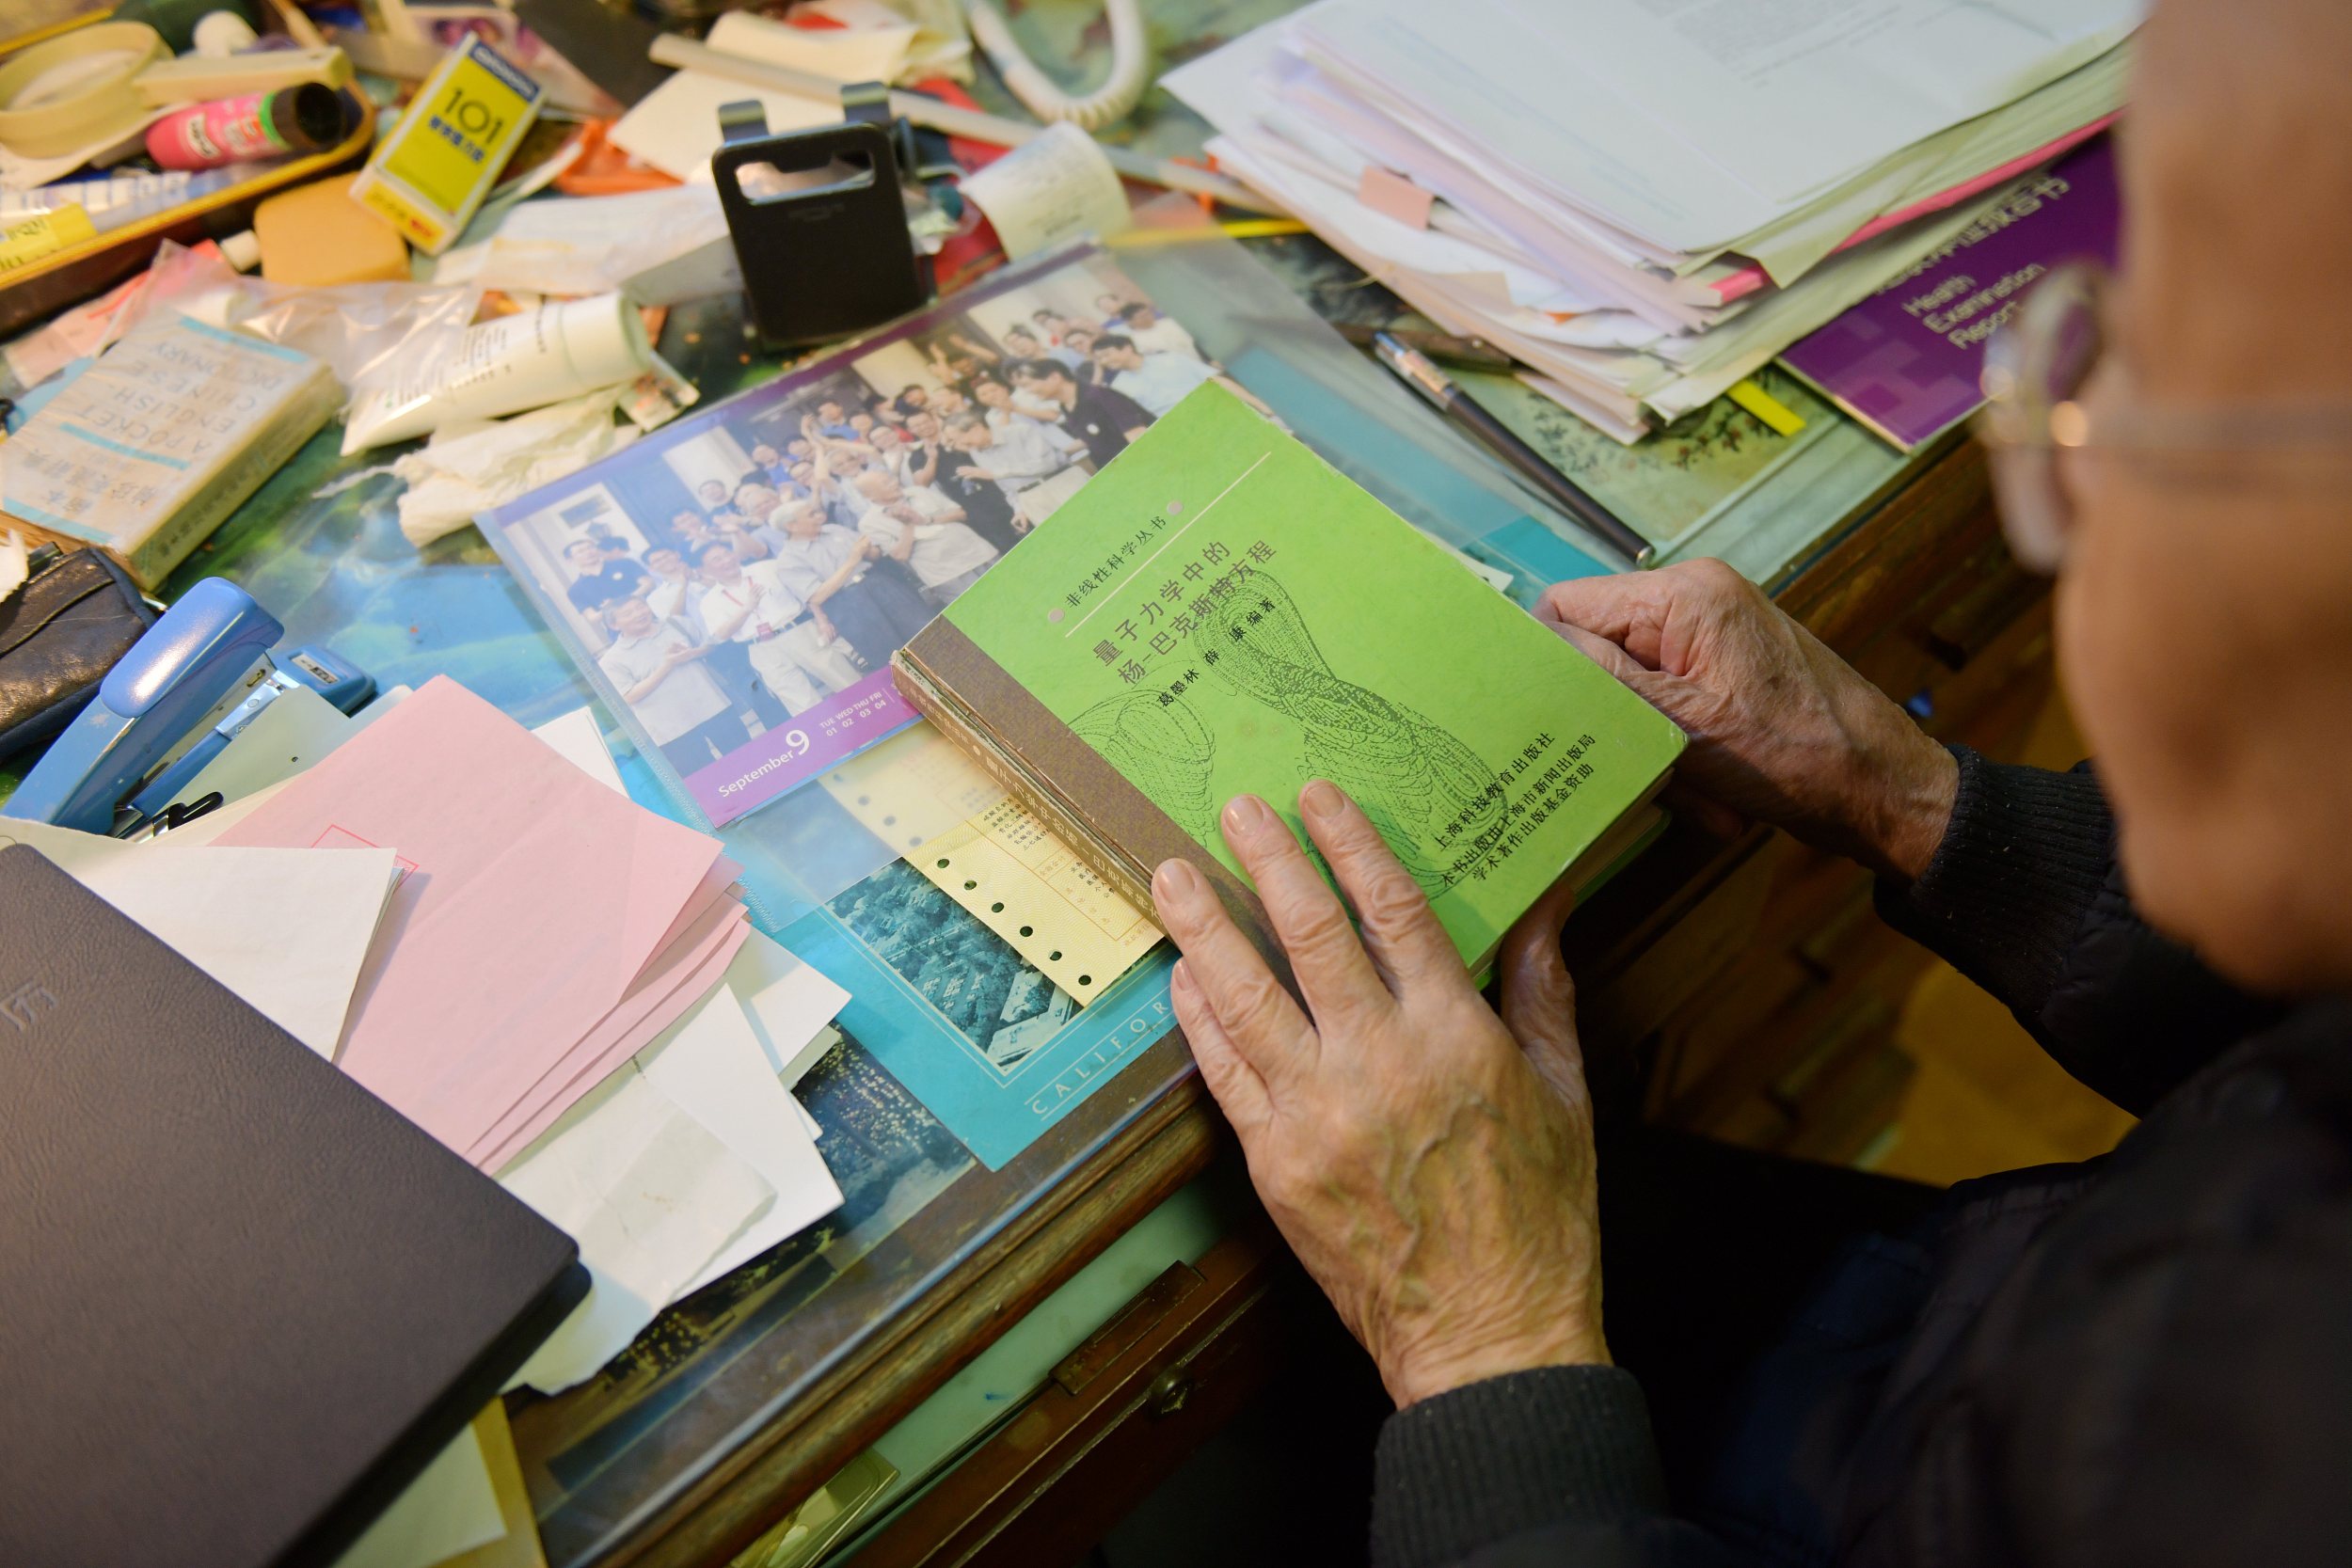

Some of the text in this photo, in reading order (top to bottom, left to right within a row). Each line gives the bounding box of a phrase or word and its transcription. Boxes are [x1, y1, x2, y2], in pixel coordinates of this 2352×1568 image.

[444, 89, 504, 145] 101
[1901, 275, 1976, 318] Health
[1923, 262, 2047, 334] Examination
[75, 404, 183, 450] POCKET
[1064, 515, 1167, 610] 非线性科学丛书
[1092, 541, 1231, 667] 量子力学中的
[1118, 539, 1277, 686] 杨-巴克斯特方程
[819, 691, 882, 729] TUE WED THU FRI
[826, 699, 886, 737] 01 02 03 04
[718, 729, 810, 798] September 9
[1433, 731, 1555, 852] 上海科技教育出版社
[1440, 733, 1597, 889] 本书出版由上海市新闻出版局
[1471, 762, 1595, 883] 学术著作出版基金资助
